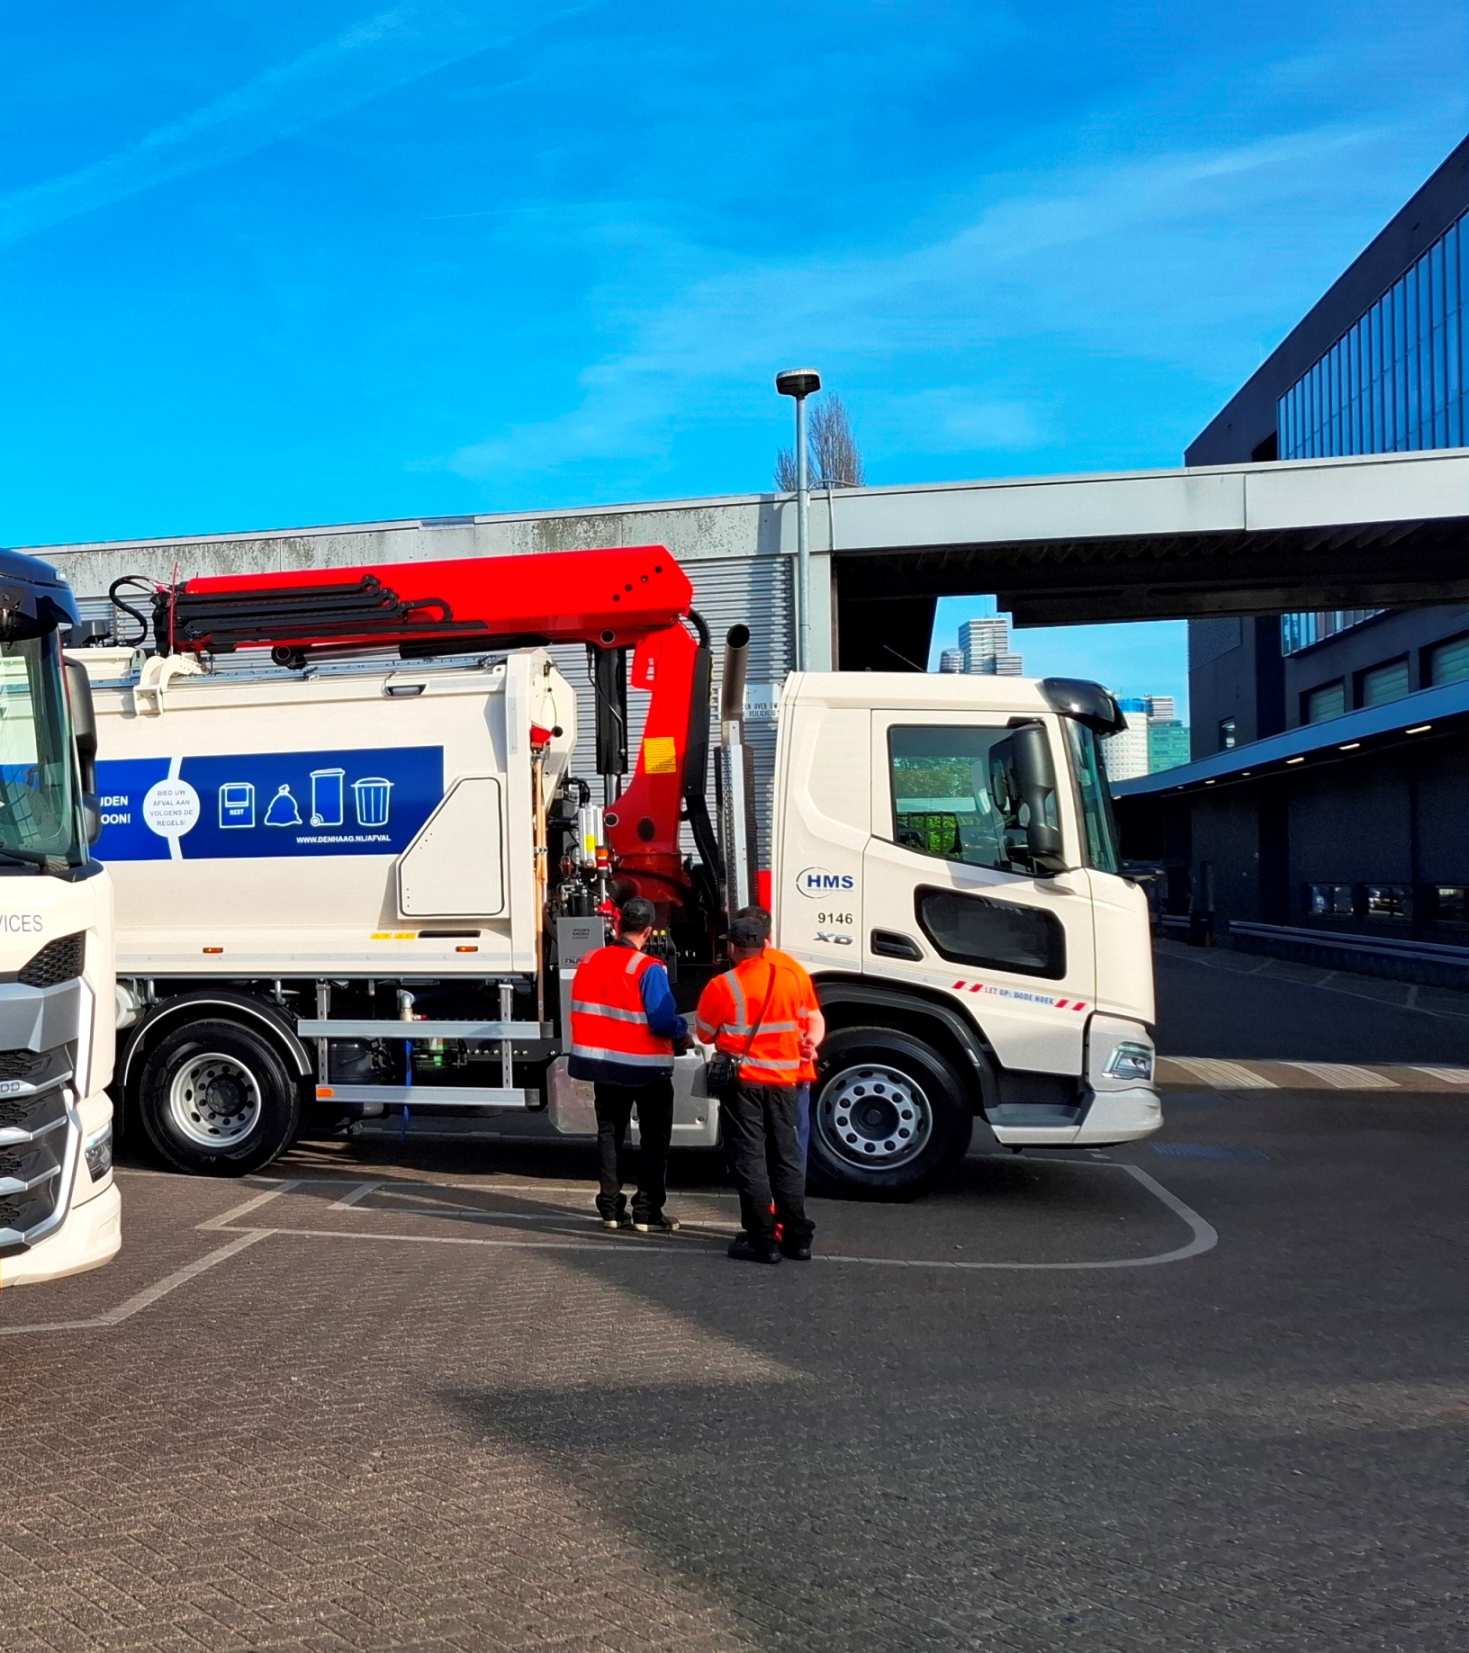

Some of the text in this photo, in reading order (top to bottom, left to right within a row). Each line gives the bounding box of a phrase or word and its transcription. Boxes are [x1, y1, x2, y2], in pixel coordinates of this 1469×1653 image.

[150, 809, 182, 817] VOLGENS
[296, 835, 392, 844] WWW.DENHAAG.NL/AFVAL
[807, 874, 854, 889] HMS
[817, 912, 853, 924] 9146
[984, 986, 998, 995] LET
[1013, 991, 1033, 1001] DODE
[1034, 994, 1055, 1005] HOEK
